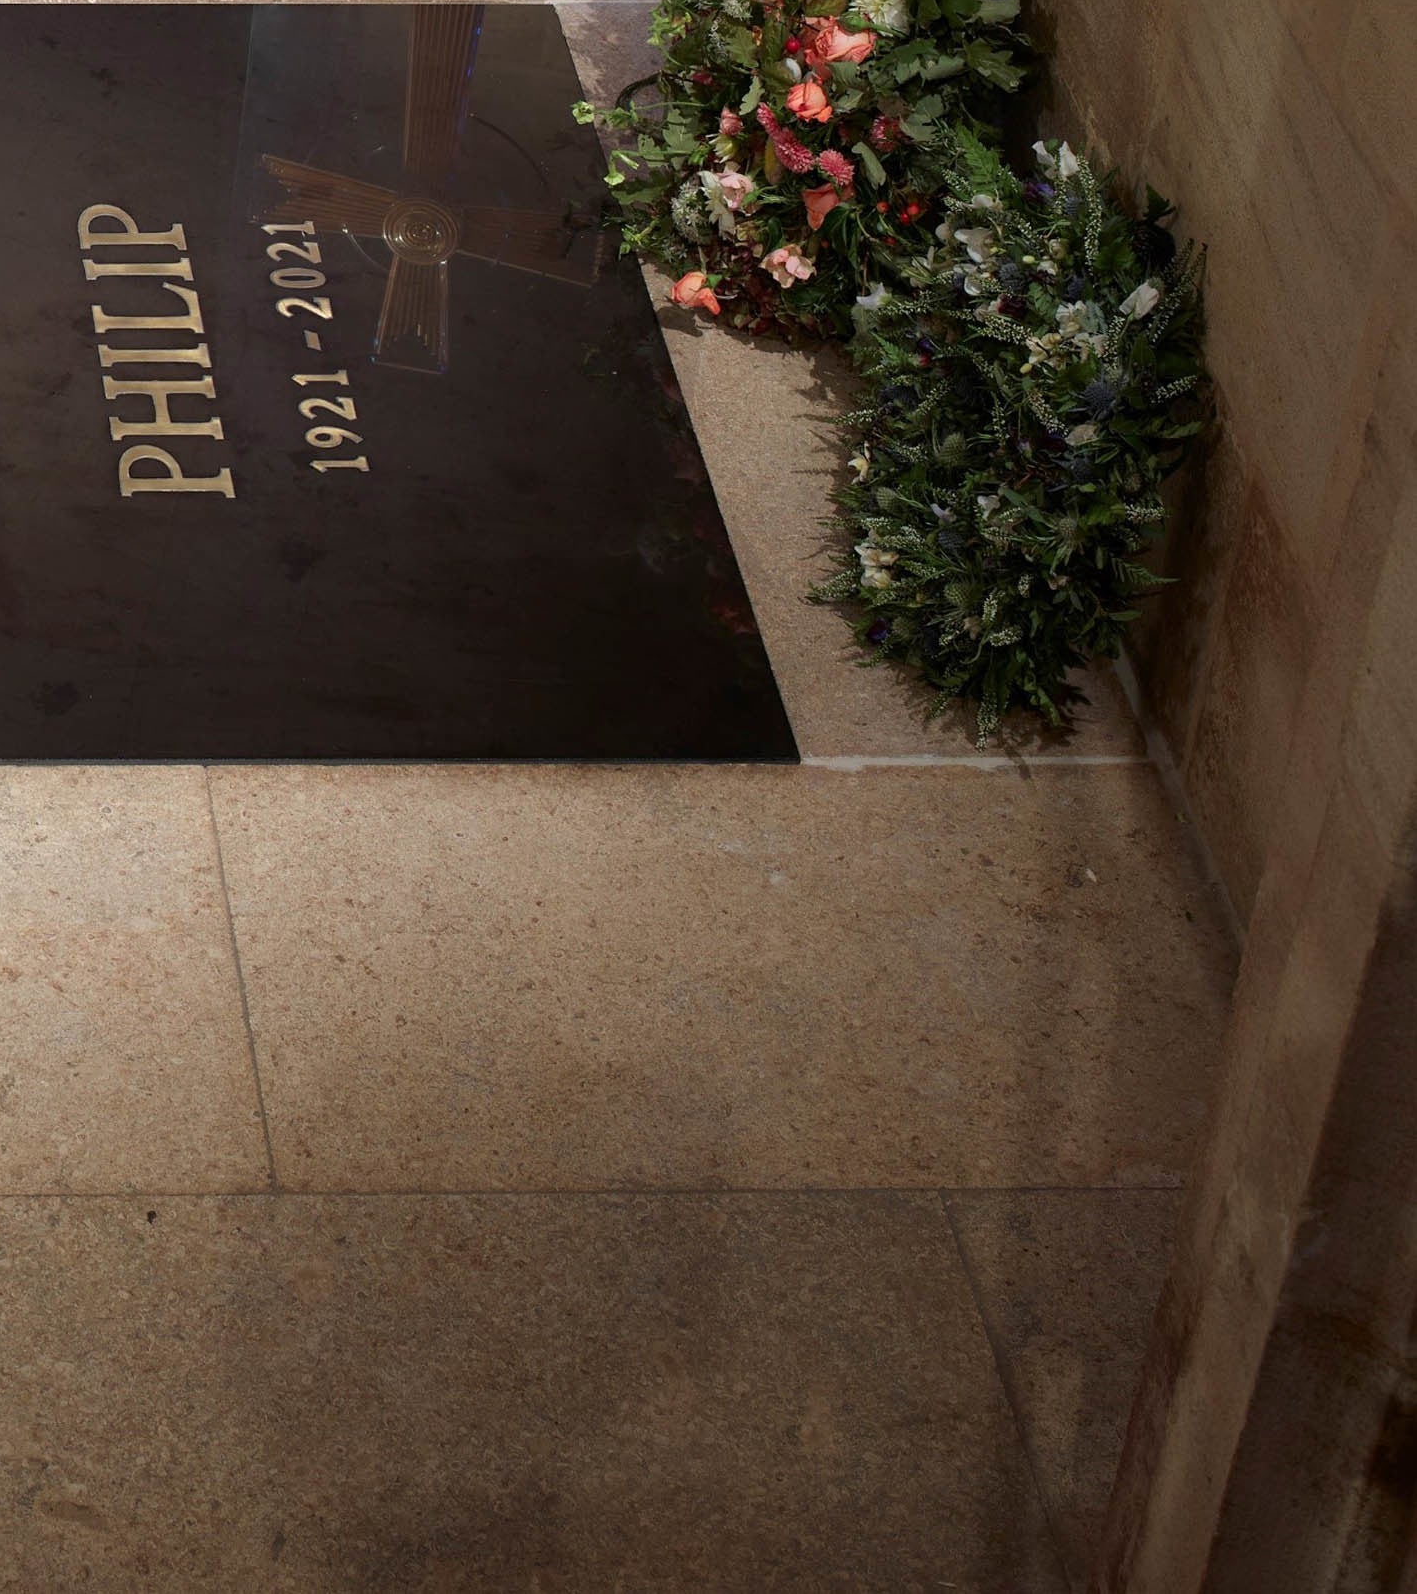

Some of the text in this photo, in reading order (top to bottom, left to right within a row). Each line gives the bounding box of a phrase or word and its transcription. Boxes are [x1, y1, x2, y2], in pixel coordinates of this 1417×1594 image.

[77, 203, 237, 499] PHILIP
[260, 220, 370, 474] 1921 - 2021
